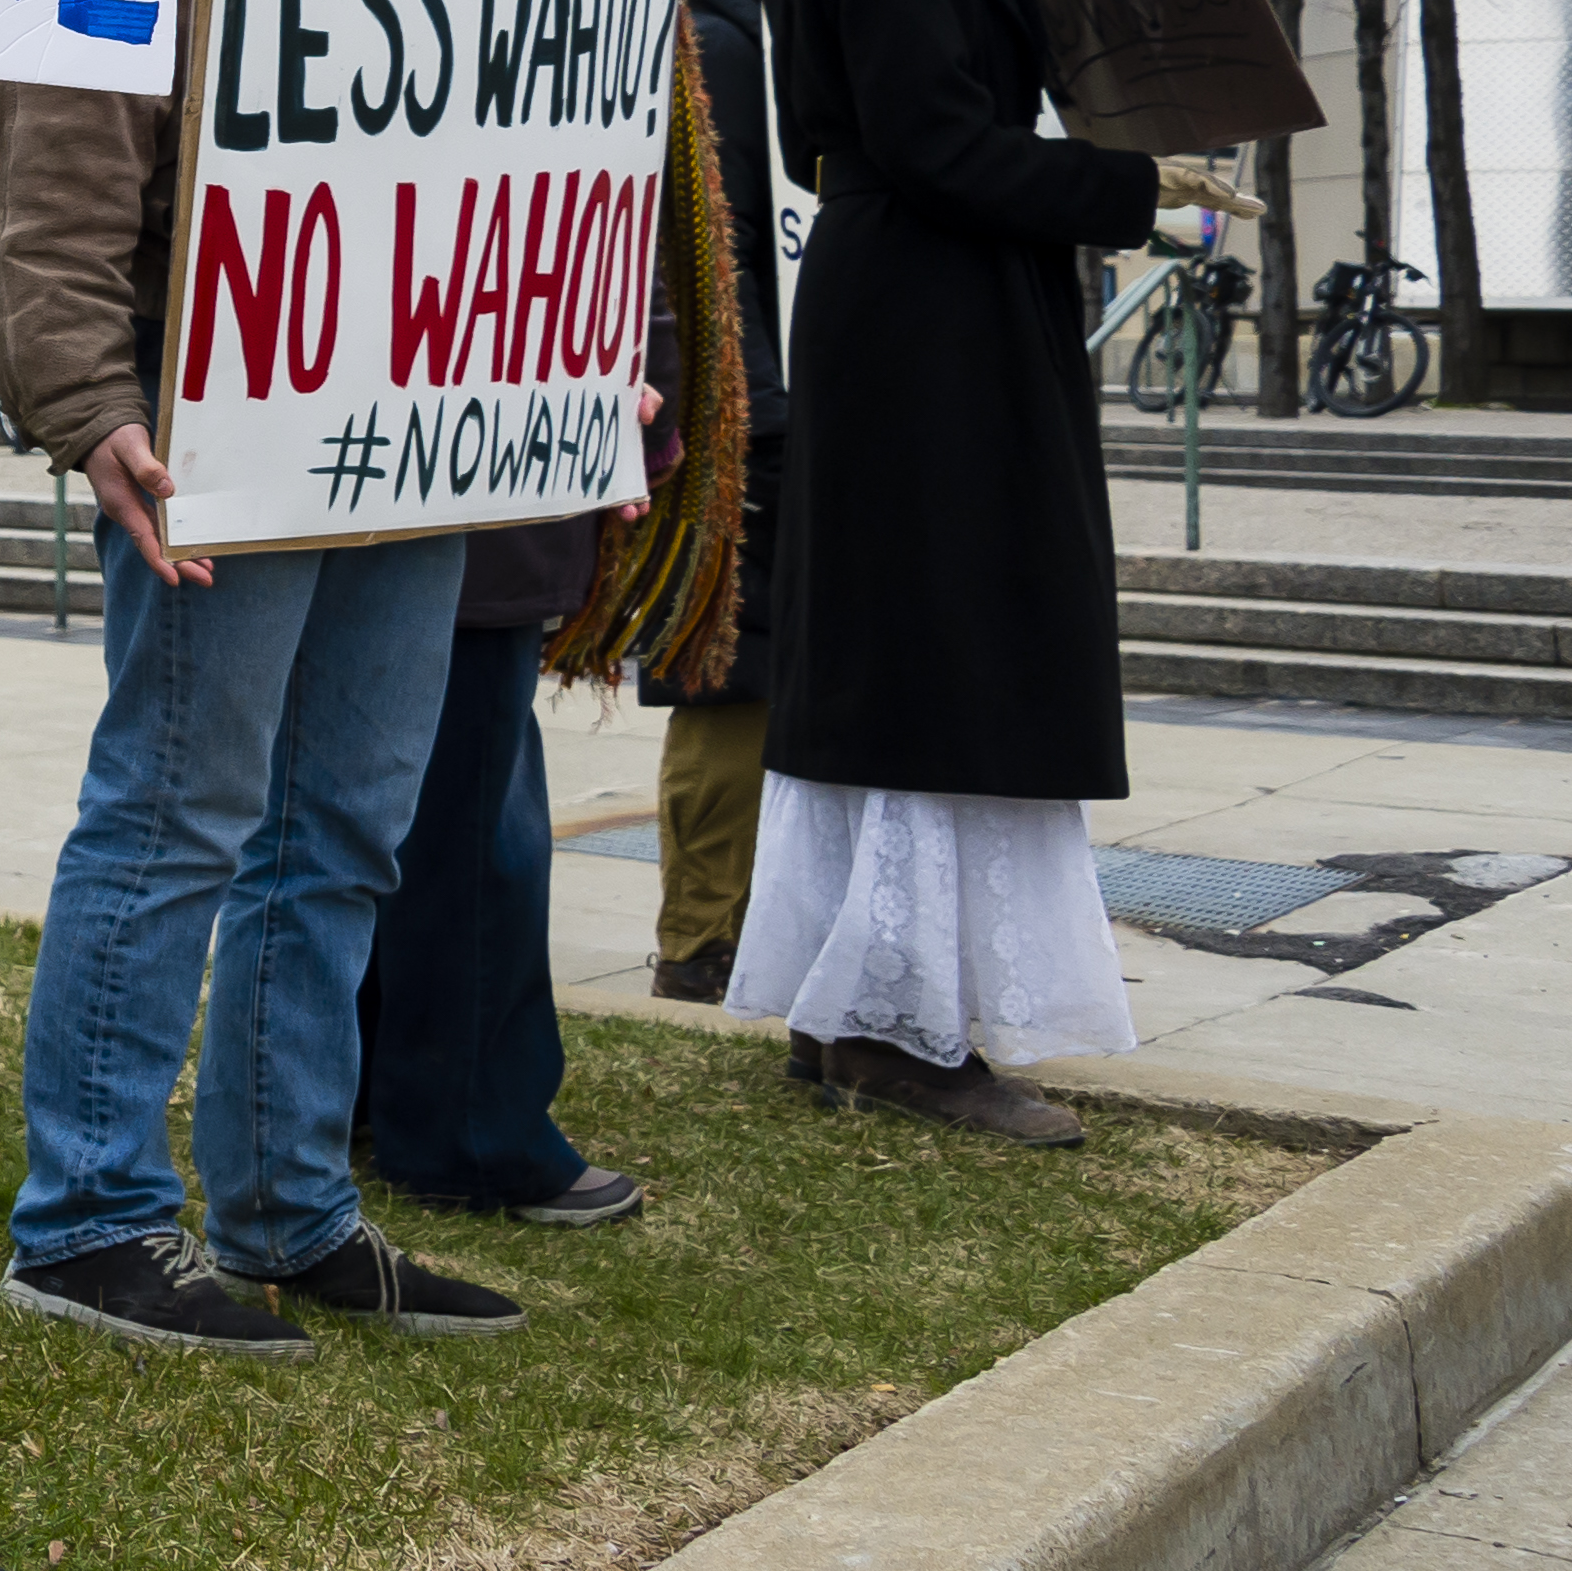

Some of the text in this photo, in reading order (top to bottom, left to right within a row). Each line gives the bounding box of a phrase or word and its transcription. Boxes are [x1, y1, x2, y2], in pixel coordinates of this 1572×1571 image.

[181, 168, 658, 403] NO WAHOO!
[305, 388, 621, 516] #NOWAHOO
